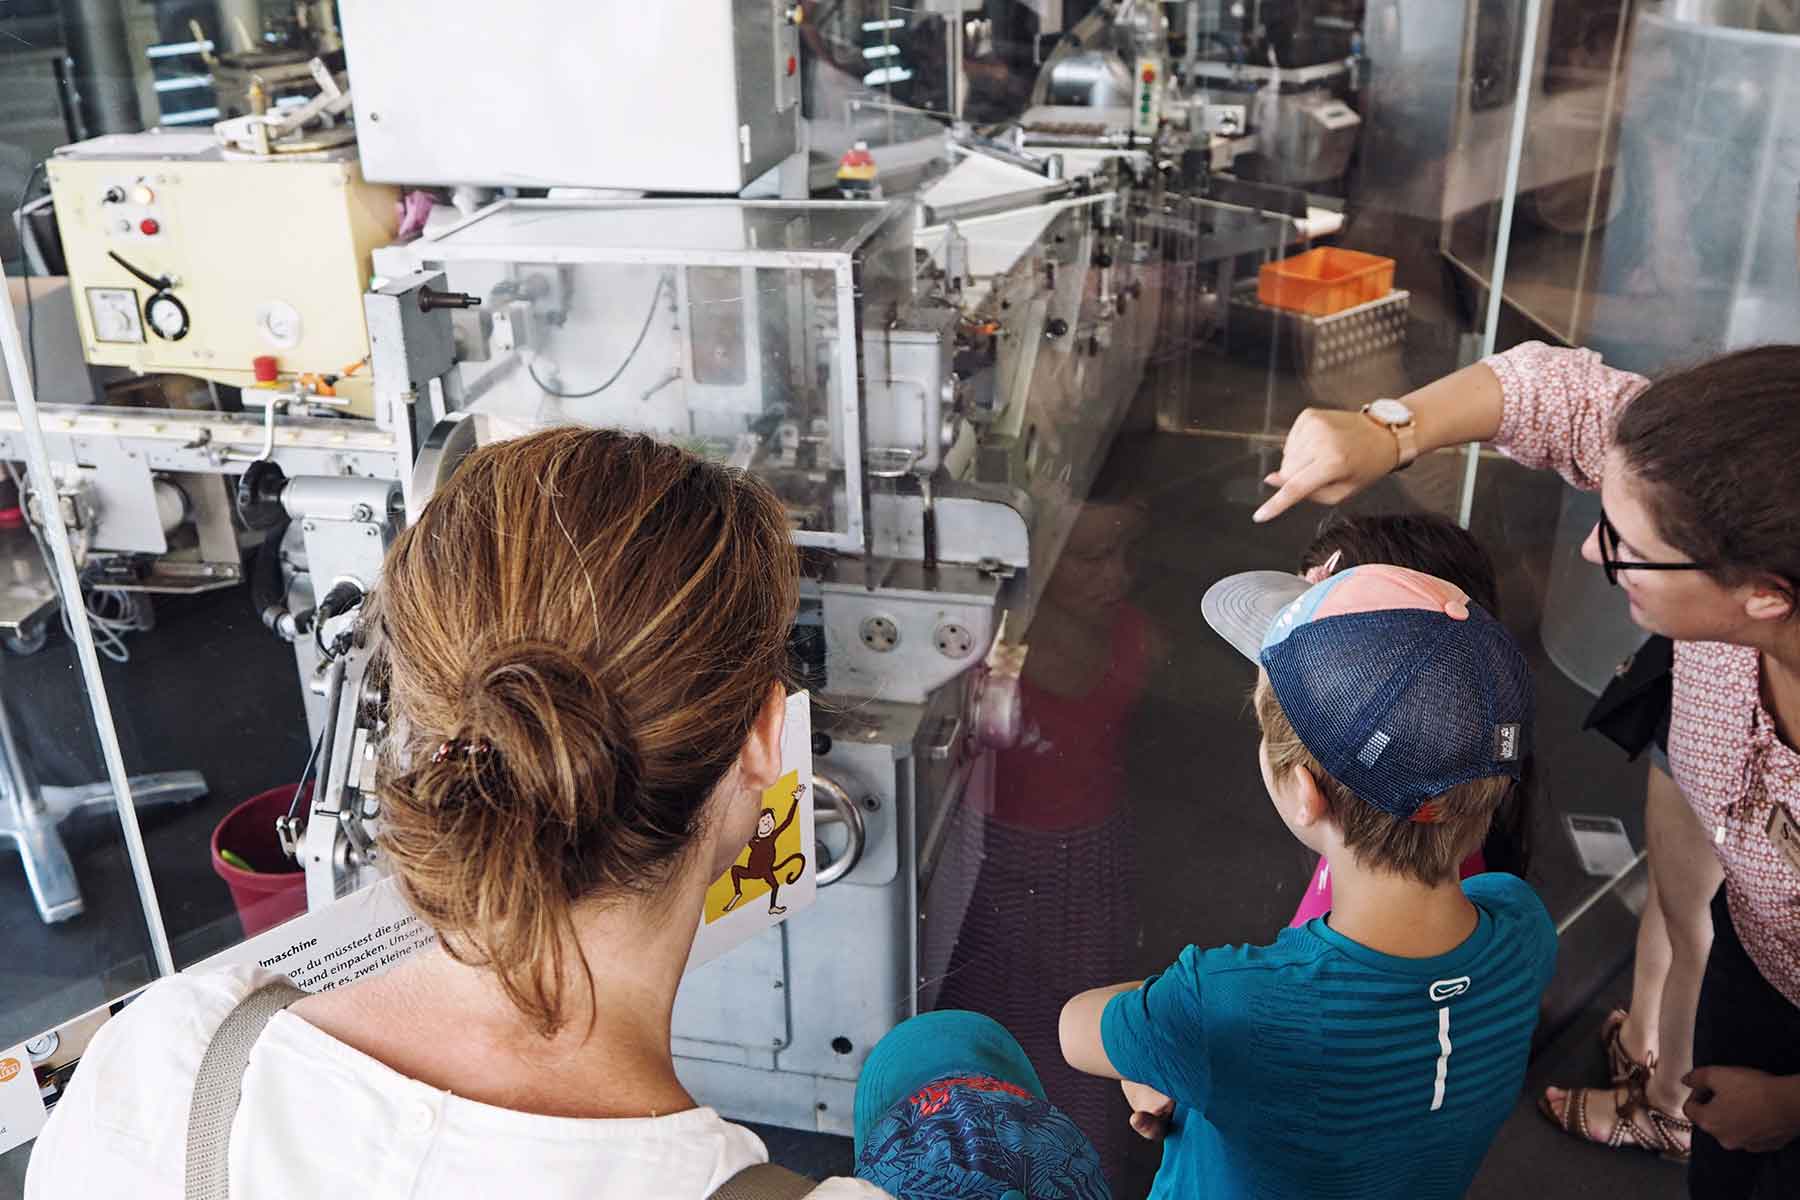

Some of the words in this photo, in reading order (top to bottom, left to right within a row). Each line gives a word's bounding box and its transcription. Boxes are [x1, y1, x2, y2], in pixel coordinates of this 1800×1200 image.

[288, 967, 305, 978] or,
[306, 959, 322, 970] du
[323, 933, 373, 962] müsstest
[375, 925, 392, 938] die
[298, 968, 328, 988] Hand
[330, 943, 388, 975] einpacken.
[338, 975, 353, 986] es,
[354, 960, 379, 979] zwei
[380, 946, 412, 966] kleine
